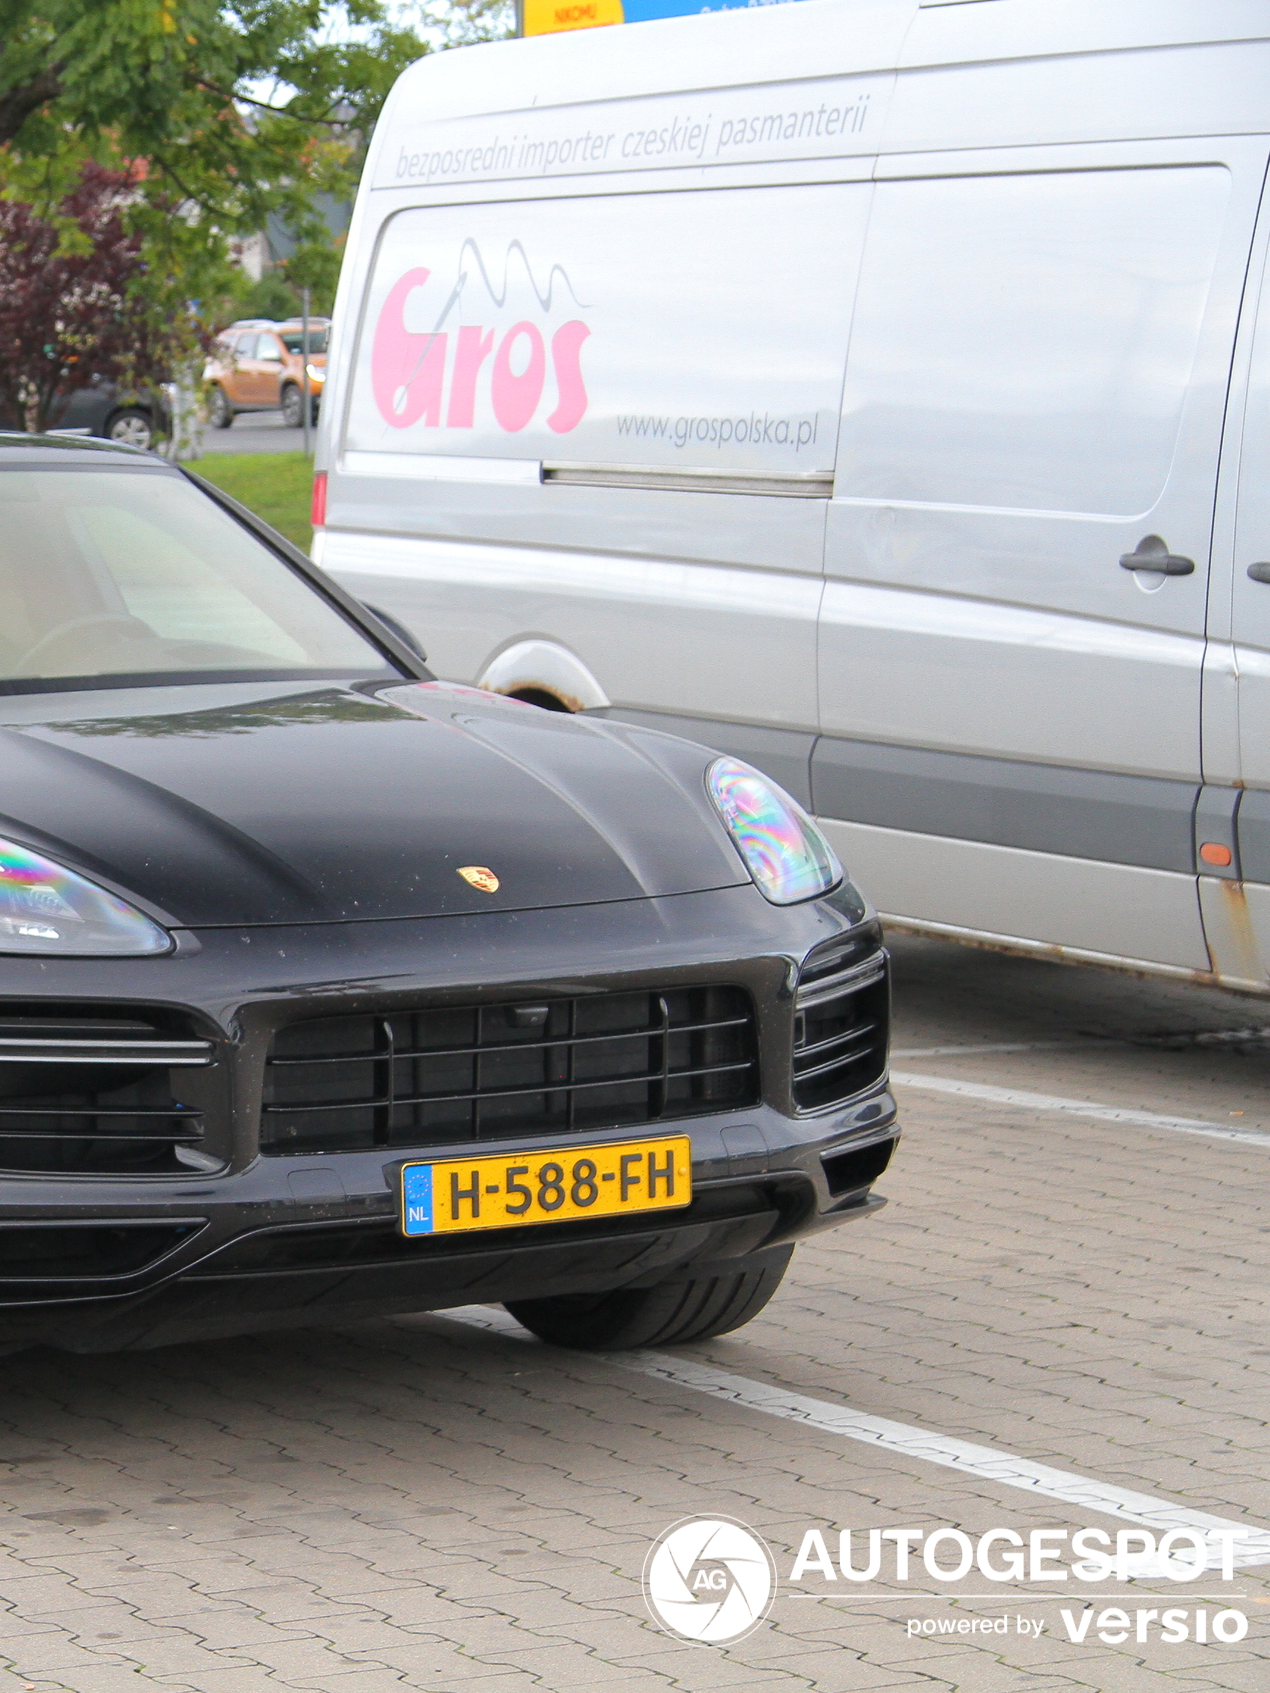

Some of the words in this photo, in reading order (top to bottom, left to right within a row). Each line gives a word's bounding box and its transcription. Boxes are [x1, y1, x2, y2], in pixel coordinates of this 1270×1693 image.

[396, 136, 516, 181] bezposredni
[518, 131, 615, 172] importer
[621, 115, 711, 161] czeskiej
[716, 95, 869, 154] pasmanterii
[371, 266, 592, 434] Gros
[616, 411, 818, 451] www.grospolska.pl
[408, 1206, 429, 1222] NL
[450, 1150, 674, 1220] H-588-FH
